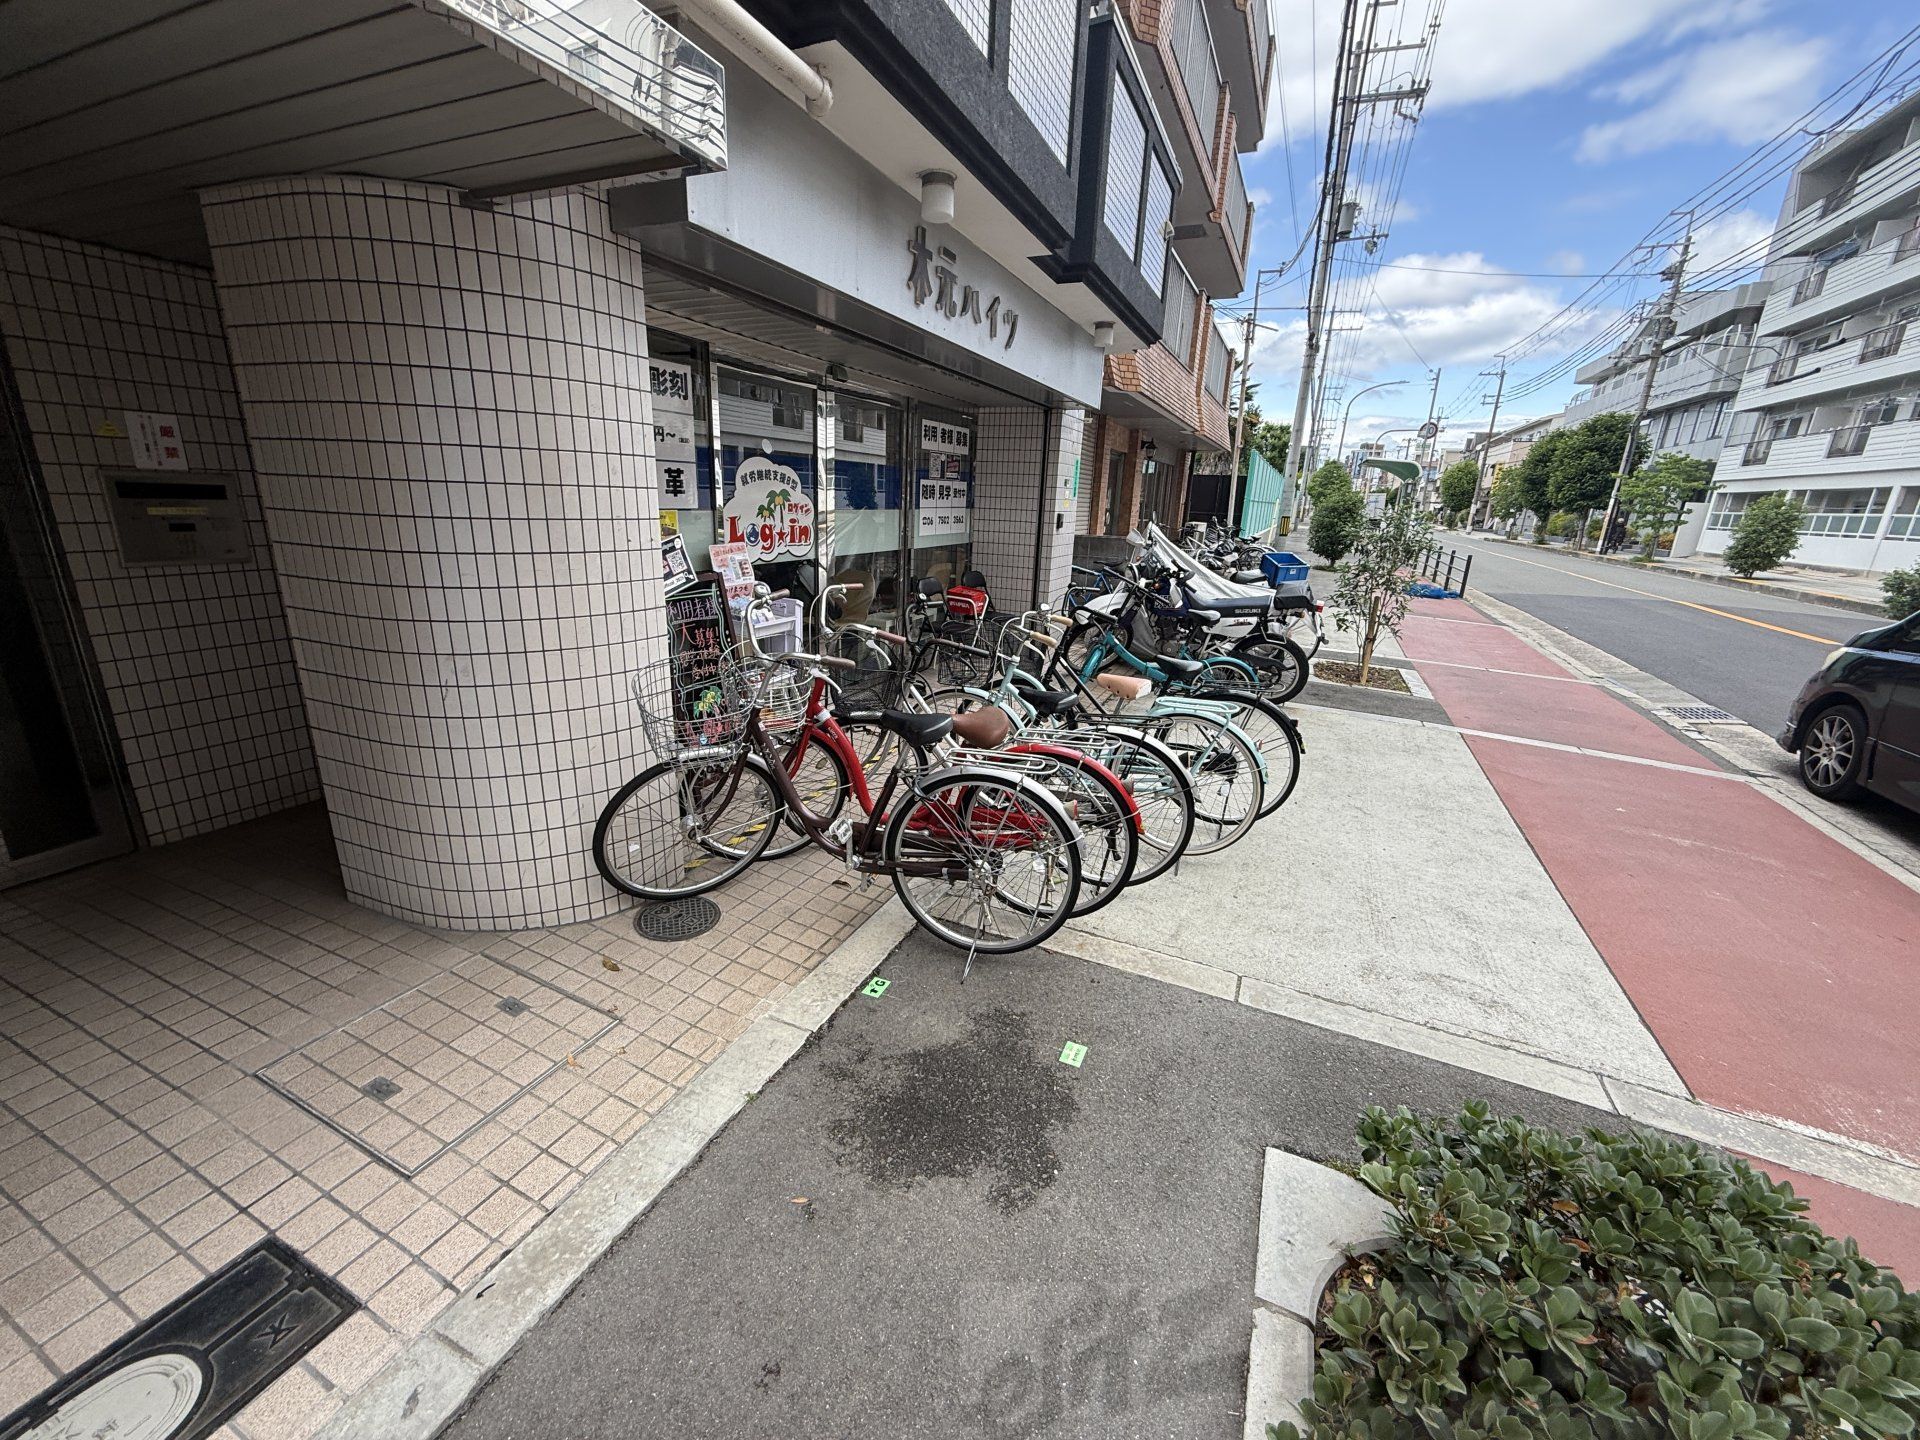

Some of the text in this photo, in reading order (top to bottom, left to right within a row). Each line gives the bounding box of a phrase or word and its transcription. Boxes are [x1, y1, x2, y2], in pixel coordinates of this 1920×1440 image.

[664, 467, 686, 497] 革
[787, 502, 812, 517] ログイン
